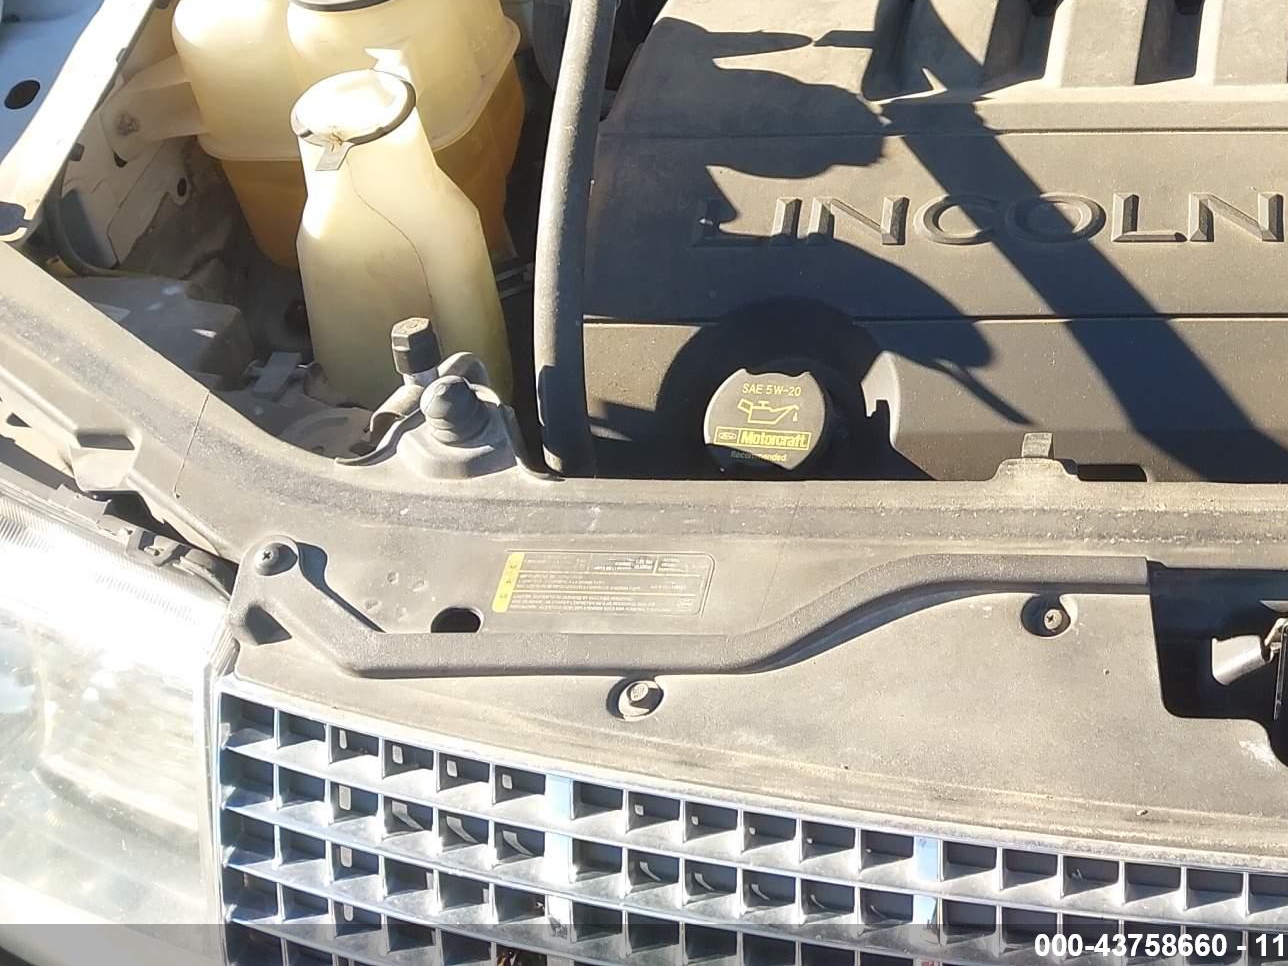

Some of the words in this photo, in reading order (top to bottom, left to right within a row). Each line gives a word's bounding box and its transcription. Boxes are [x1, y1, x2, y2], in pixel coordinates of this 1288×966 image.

[692, 192, 1285, 247] LINCOLN
[741, 382, 764, 395] SAE
[765, 384, 802, 397] 5W-20
[740, 430, 808, 448] Motorcraft
